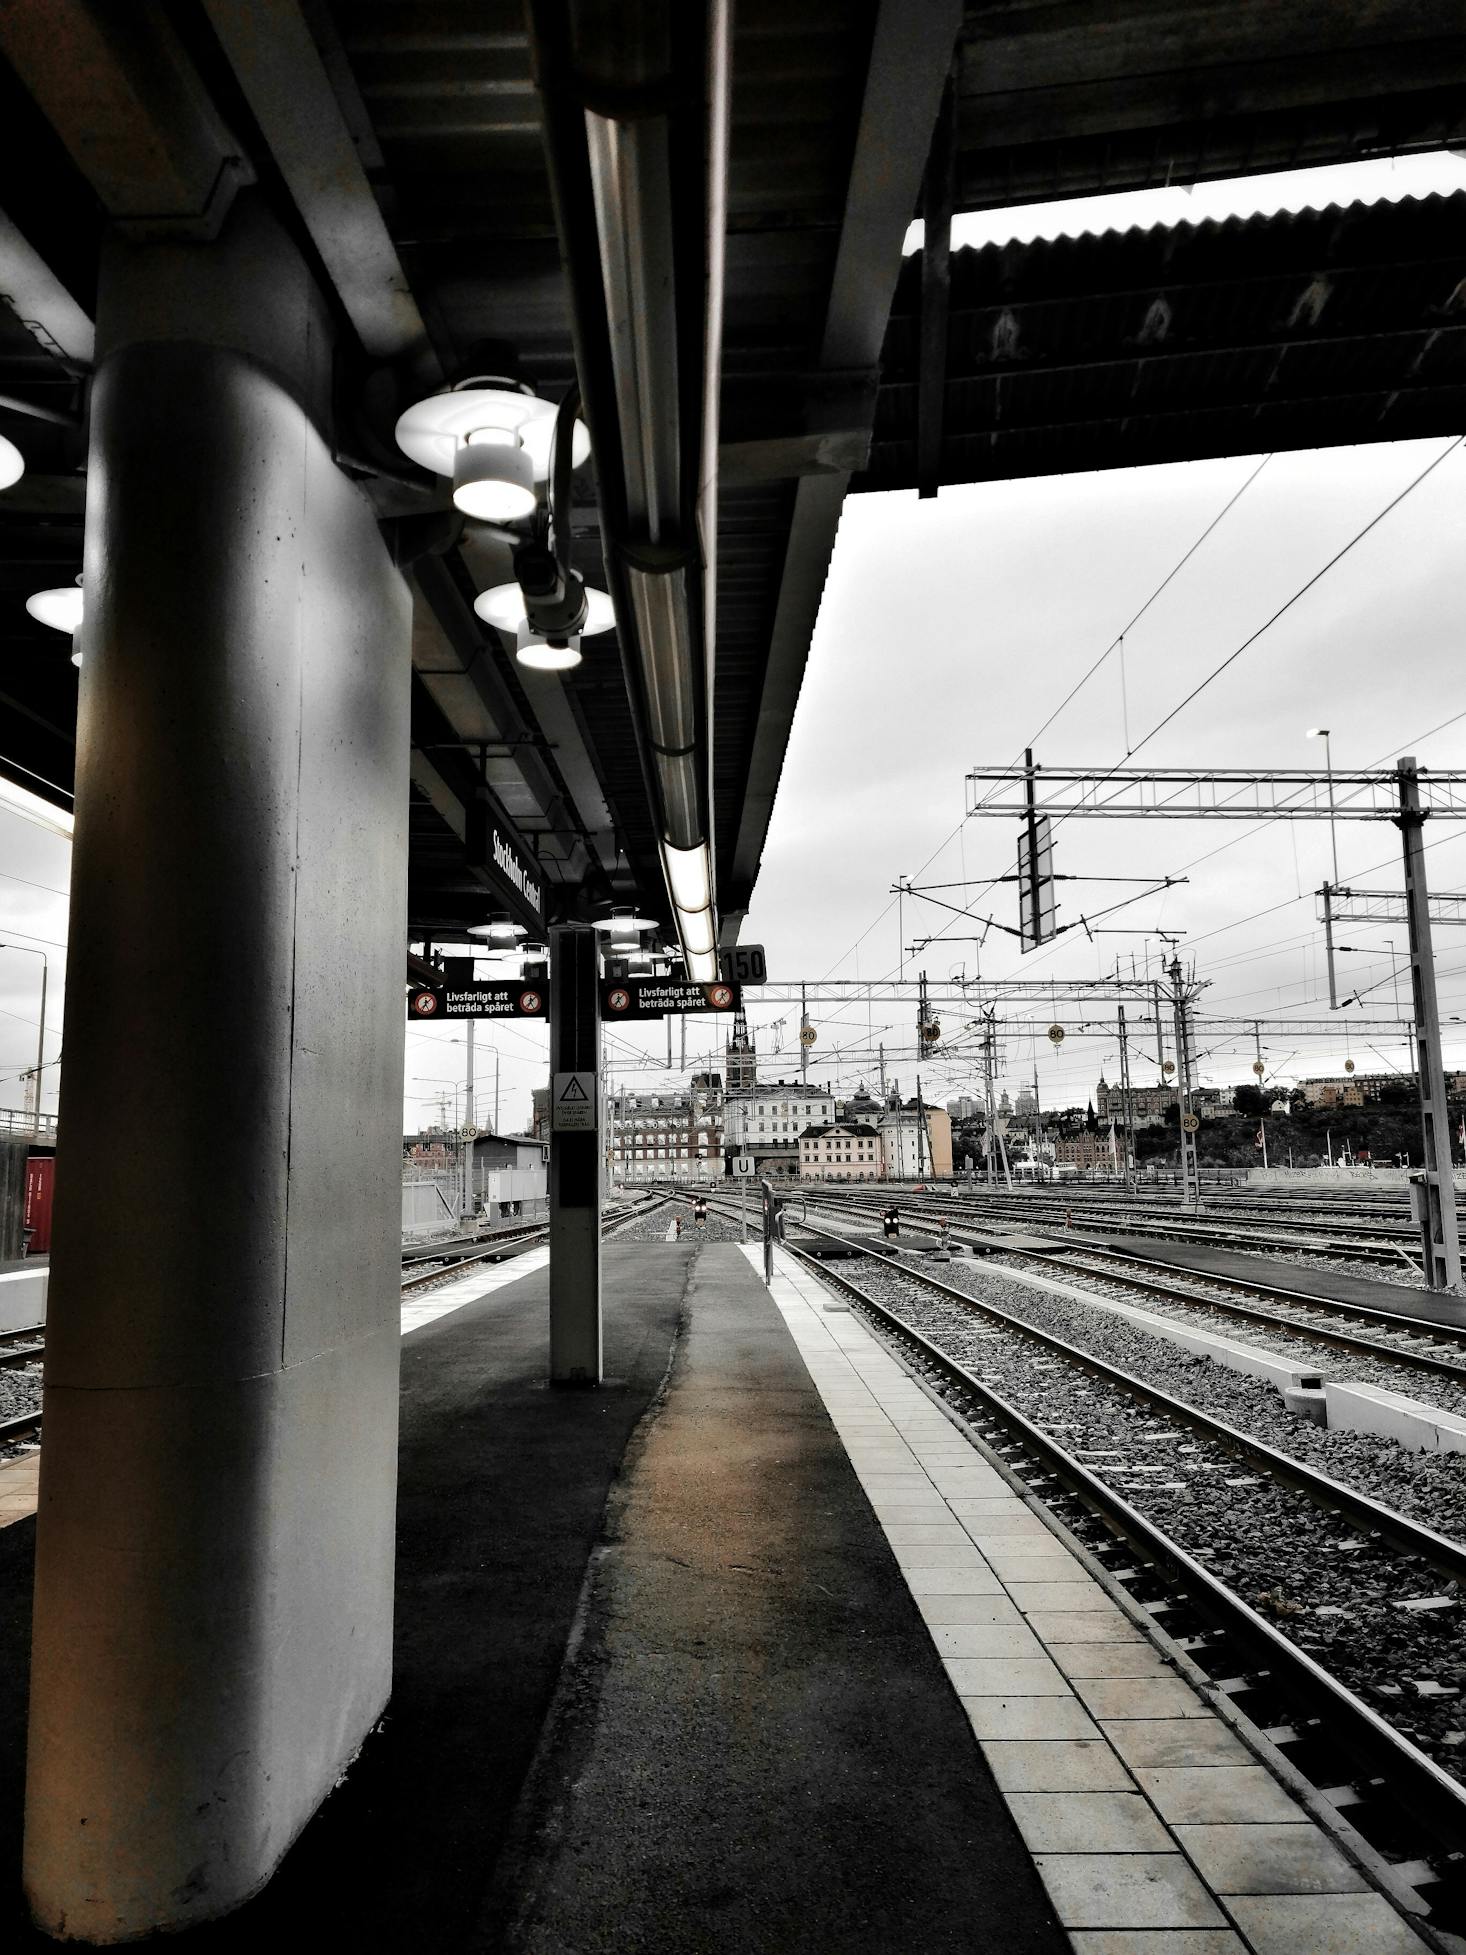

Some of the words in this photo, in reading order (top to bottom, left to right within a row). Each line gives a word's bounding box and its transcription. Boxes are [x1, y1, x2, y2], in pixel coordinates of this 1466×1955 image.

[493, 829, 522, 892] Stockholm
[523, 869, 541, 914] Central
[724, 951, 764, 981] 150
[446, 992, 492, 1003] Livsfarligt
[494, 992, 508, 1001] att
[639, 987, 684, 998] Livsfarligt
[686, 987, 701, 996] att
[446, 1002, 482, 1013] beträda
[484, 1002, 514, 1013] spåret
[639, 998, 675, 1008] beträda
[677, 997, 706, 1009] spåret
[802, 1031, 815, 1041] 80
[1050, 1029, 1063, 1039] 80
[1184, 1118, 1198, 1128] 80
[461, 1127, 476, 1137] 80
[738, 1159, 749, 1173] U
